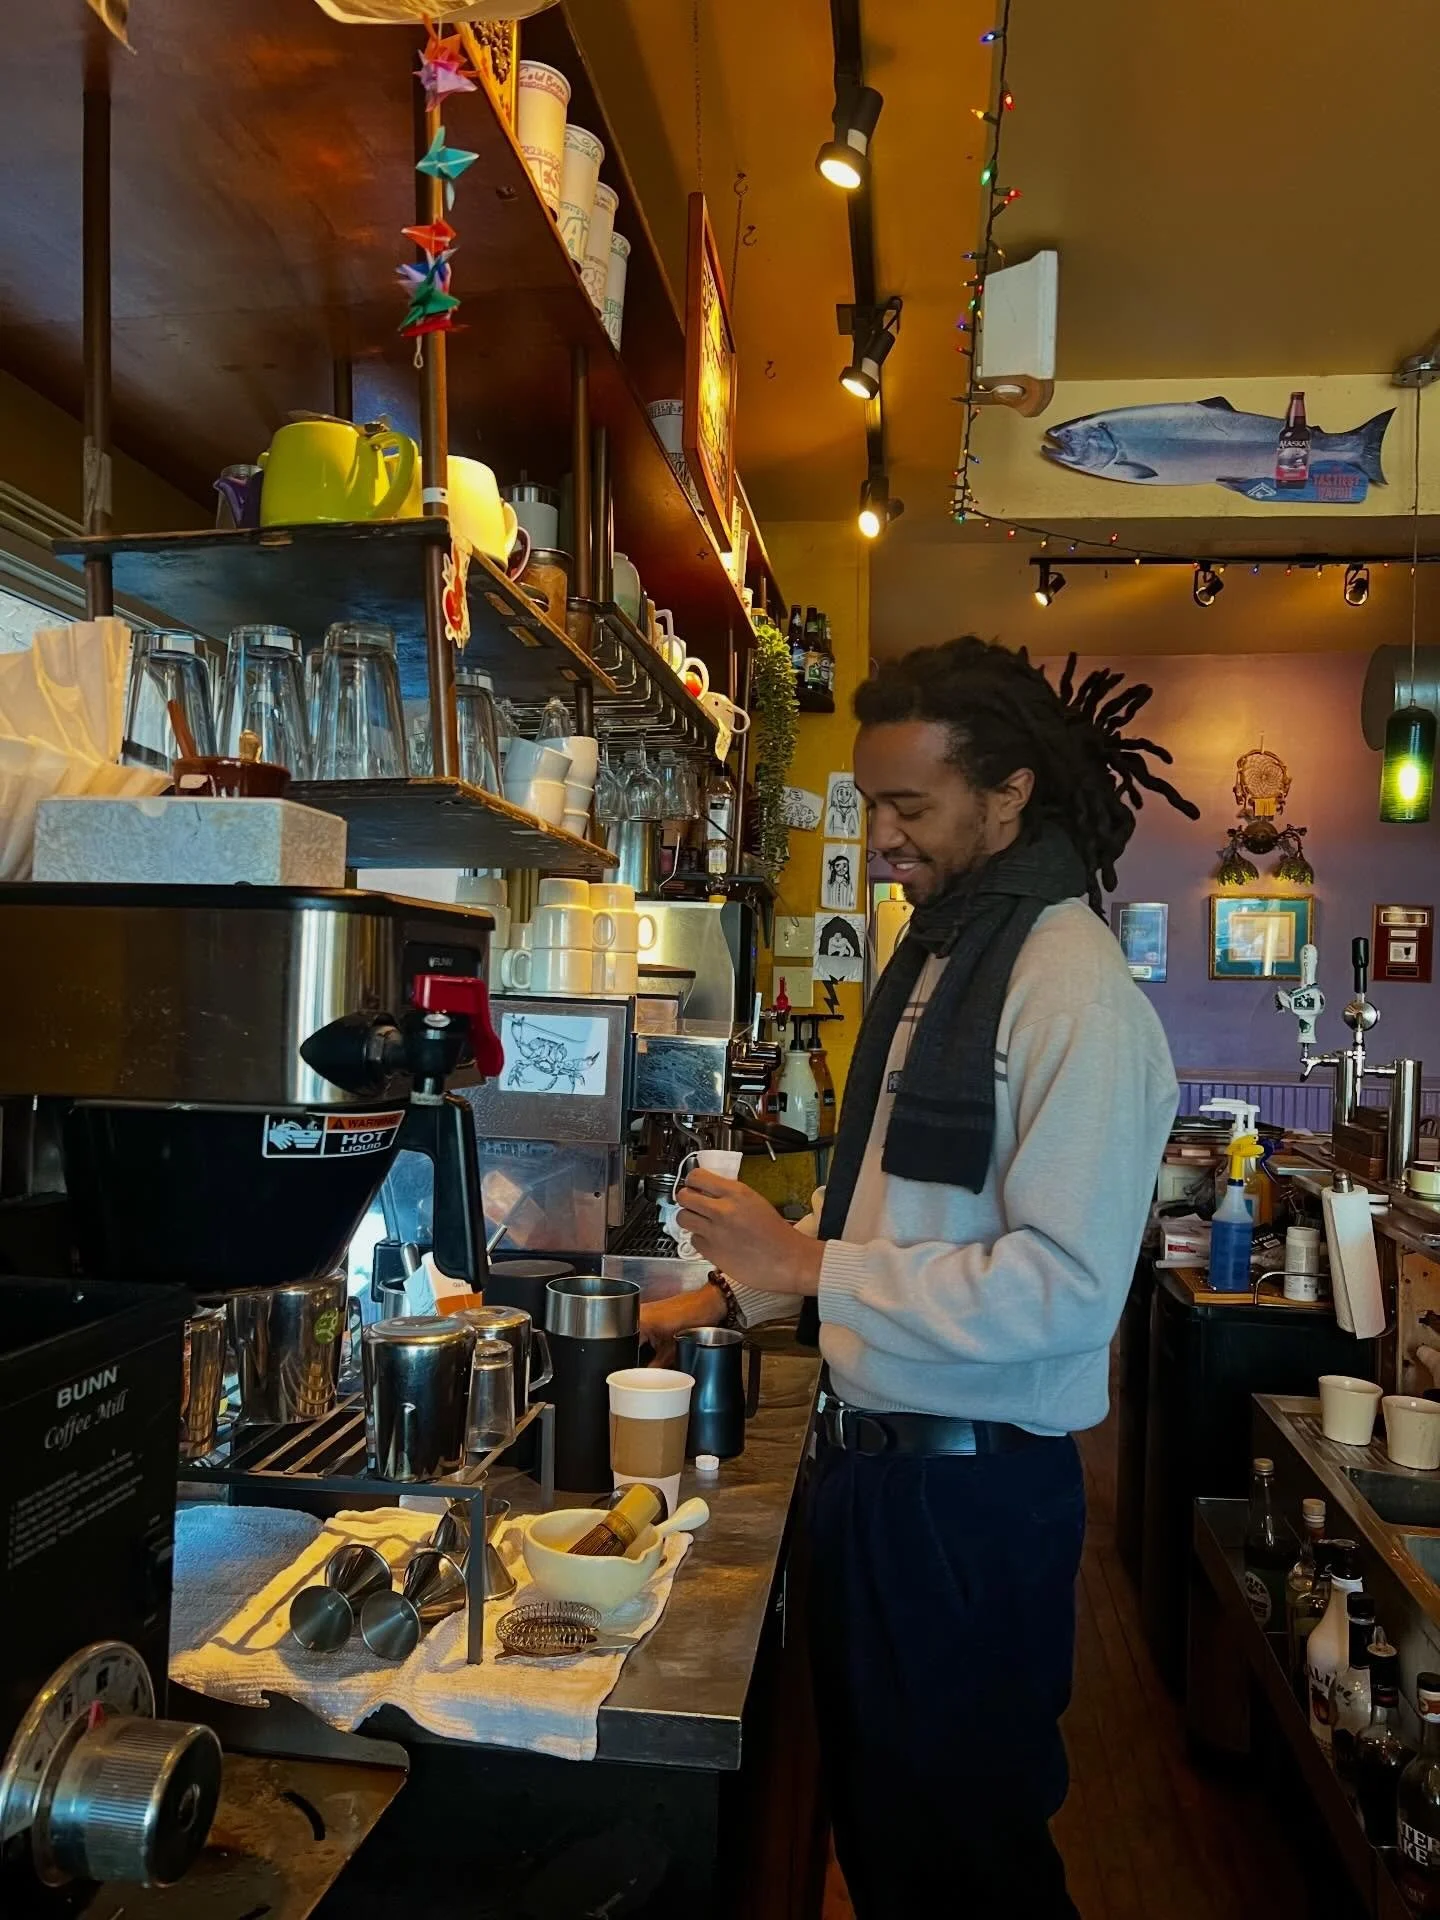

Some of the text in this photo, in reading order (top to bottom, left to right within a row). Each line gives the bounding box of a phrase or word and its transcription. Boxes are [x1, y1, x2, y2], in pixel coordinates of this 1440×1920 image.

[348, 1115, 397, 1128] WARNING
[341, 1131, 387, 1145] HOT
[340, 1142, 382, 1153] LIQUID
[56, 1366, 118, 1409] BUNN
[44, 1388, 129, 1451] Coffee Mill
